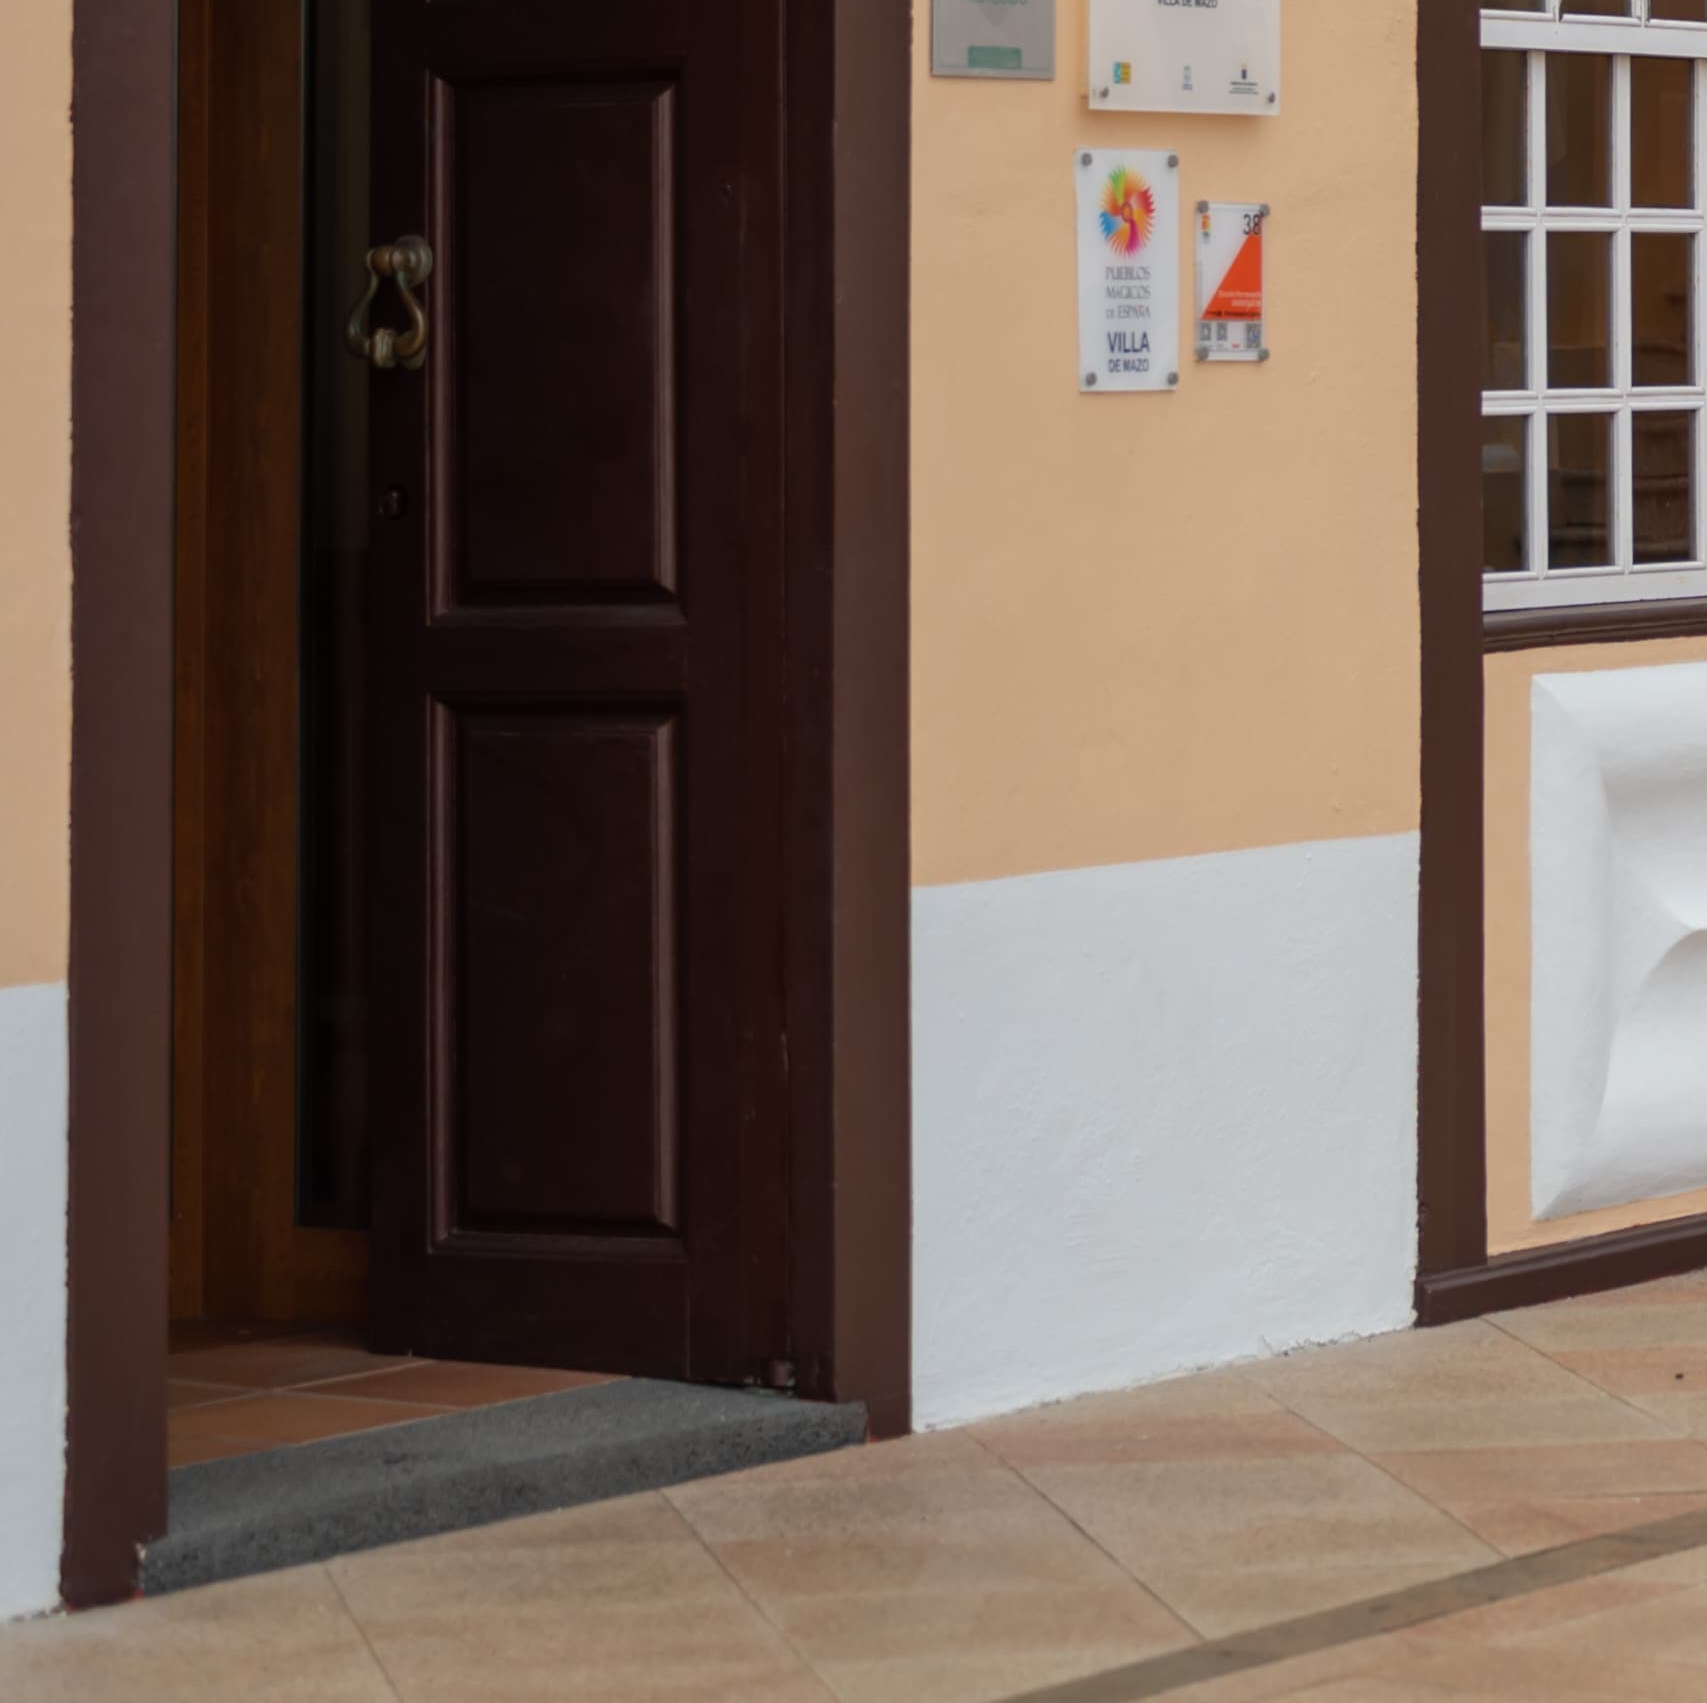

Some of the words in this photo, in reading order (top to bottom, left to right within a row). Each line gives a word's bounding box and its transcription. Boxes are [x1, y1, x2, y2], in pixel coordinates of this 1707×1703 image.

[1105, 266, 1151, 280] PUEBLOS
[1107, 331, 1150, 353] VILLA
[1108, 358, 1121, 373] DE
[1122, 358, 1150, 373] MAZO
